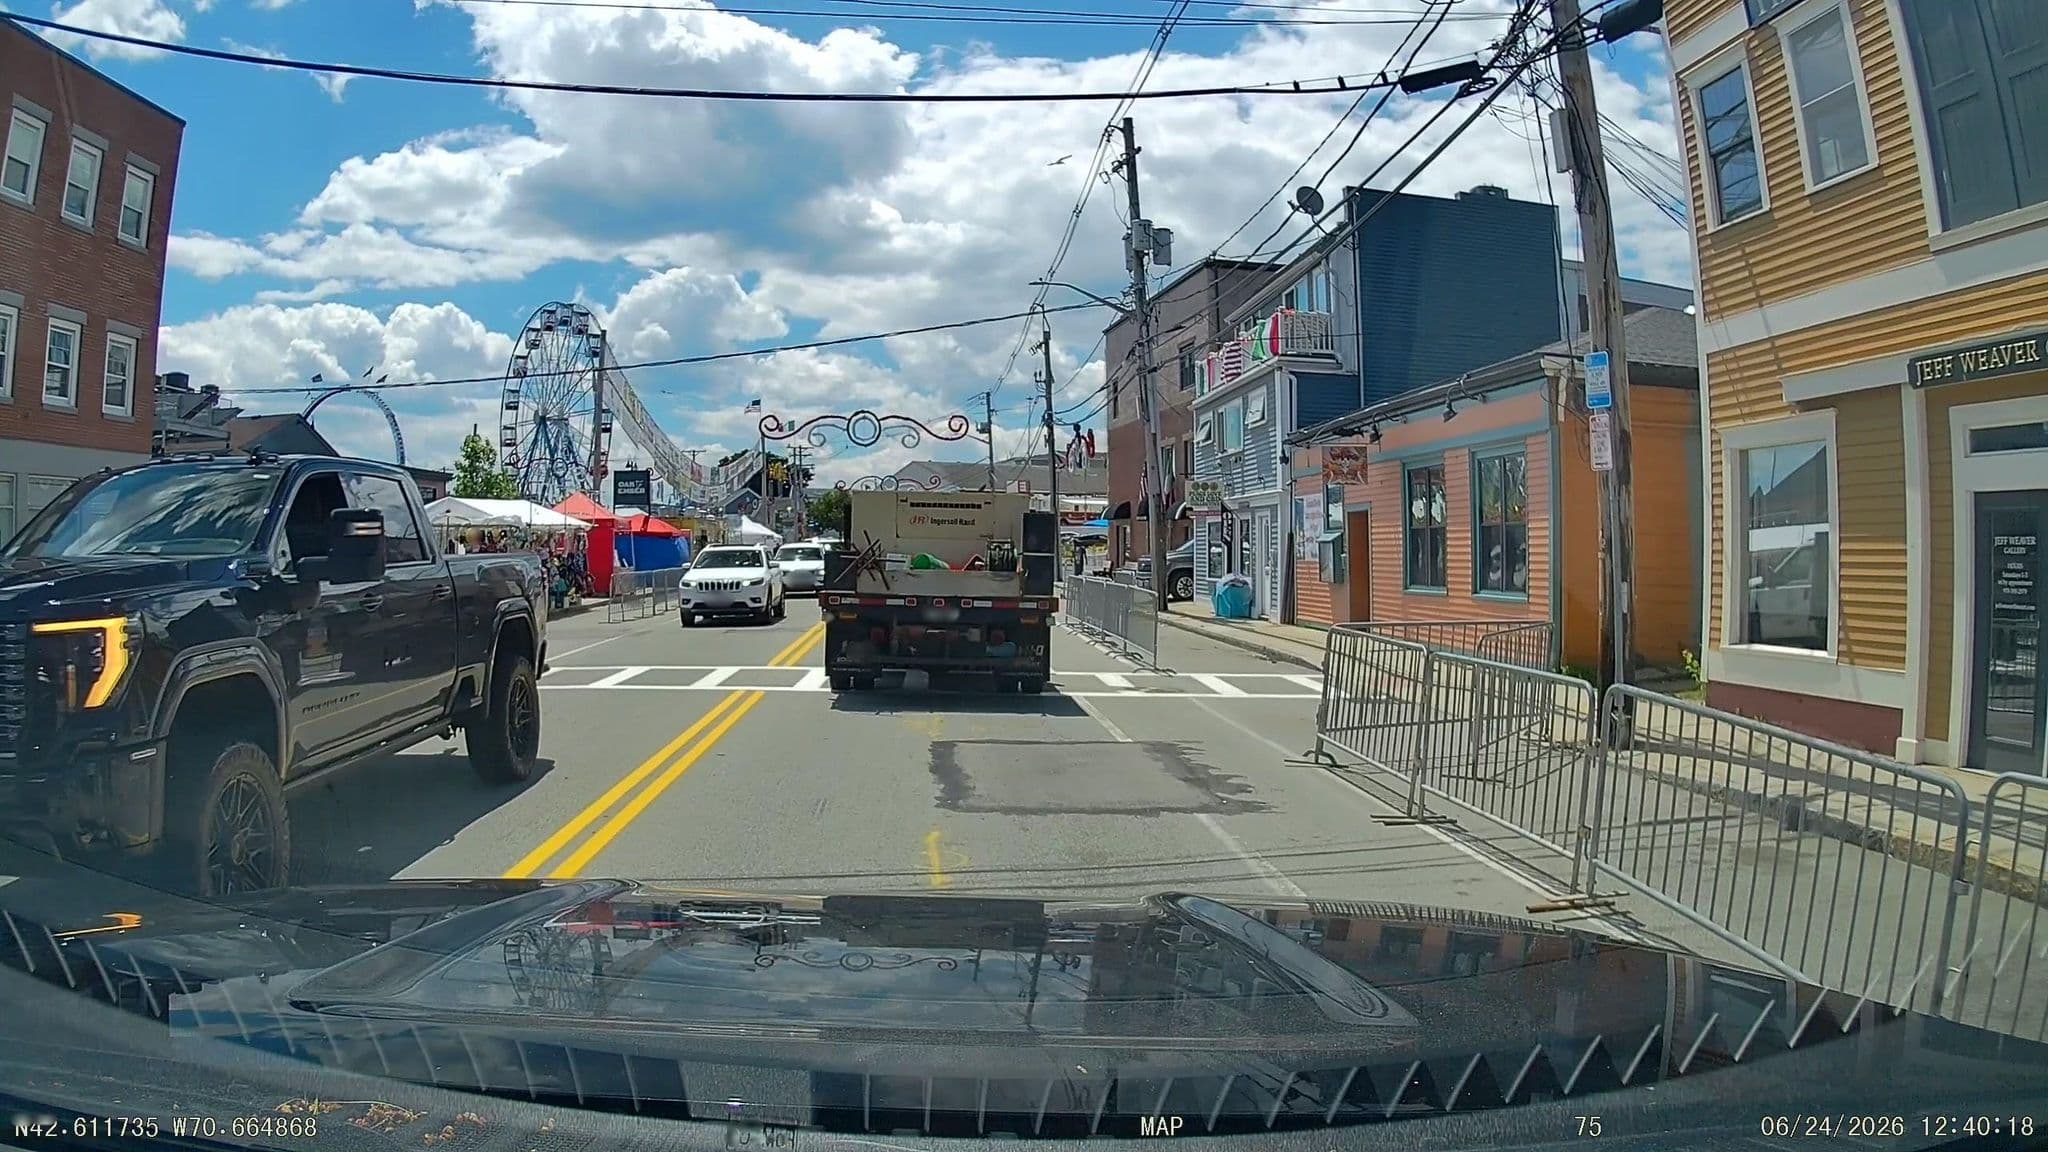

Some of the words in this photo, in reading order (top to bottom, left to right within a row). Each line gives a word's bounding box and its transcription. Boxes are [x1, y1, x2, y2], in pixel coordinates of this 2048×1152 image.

[1915, 355, 1953, 386] JEFF
[1958, 340, 2040, 373] WEAVER
[930, 517, 958, 526] Ingersoll
[959, 517, 976, 526] Rand
[1994, 536, 2008, 546] JEFF
[2008, 536, 2036, 545] WEAVER
